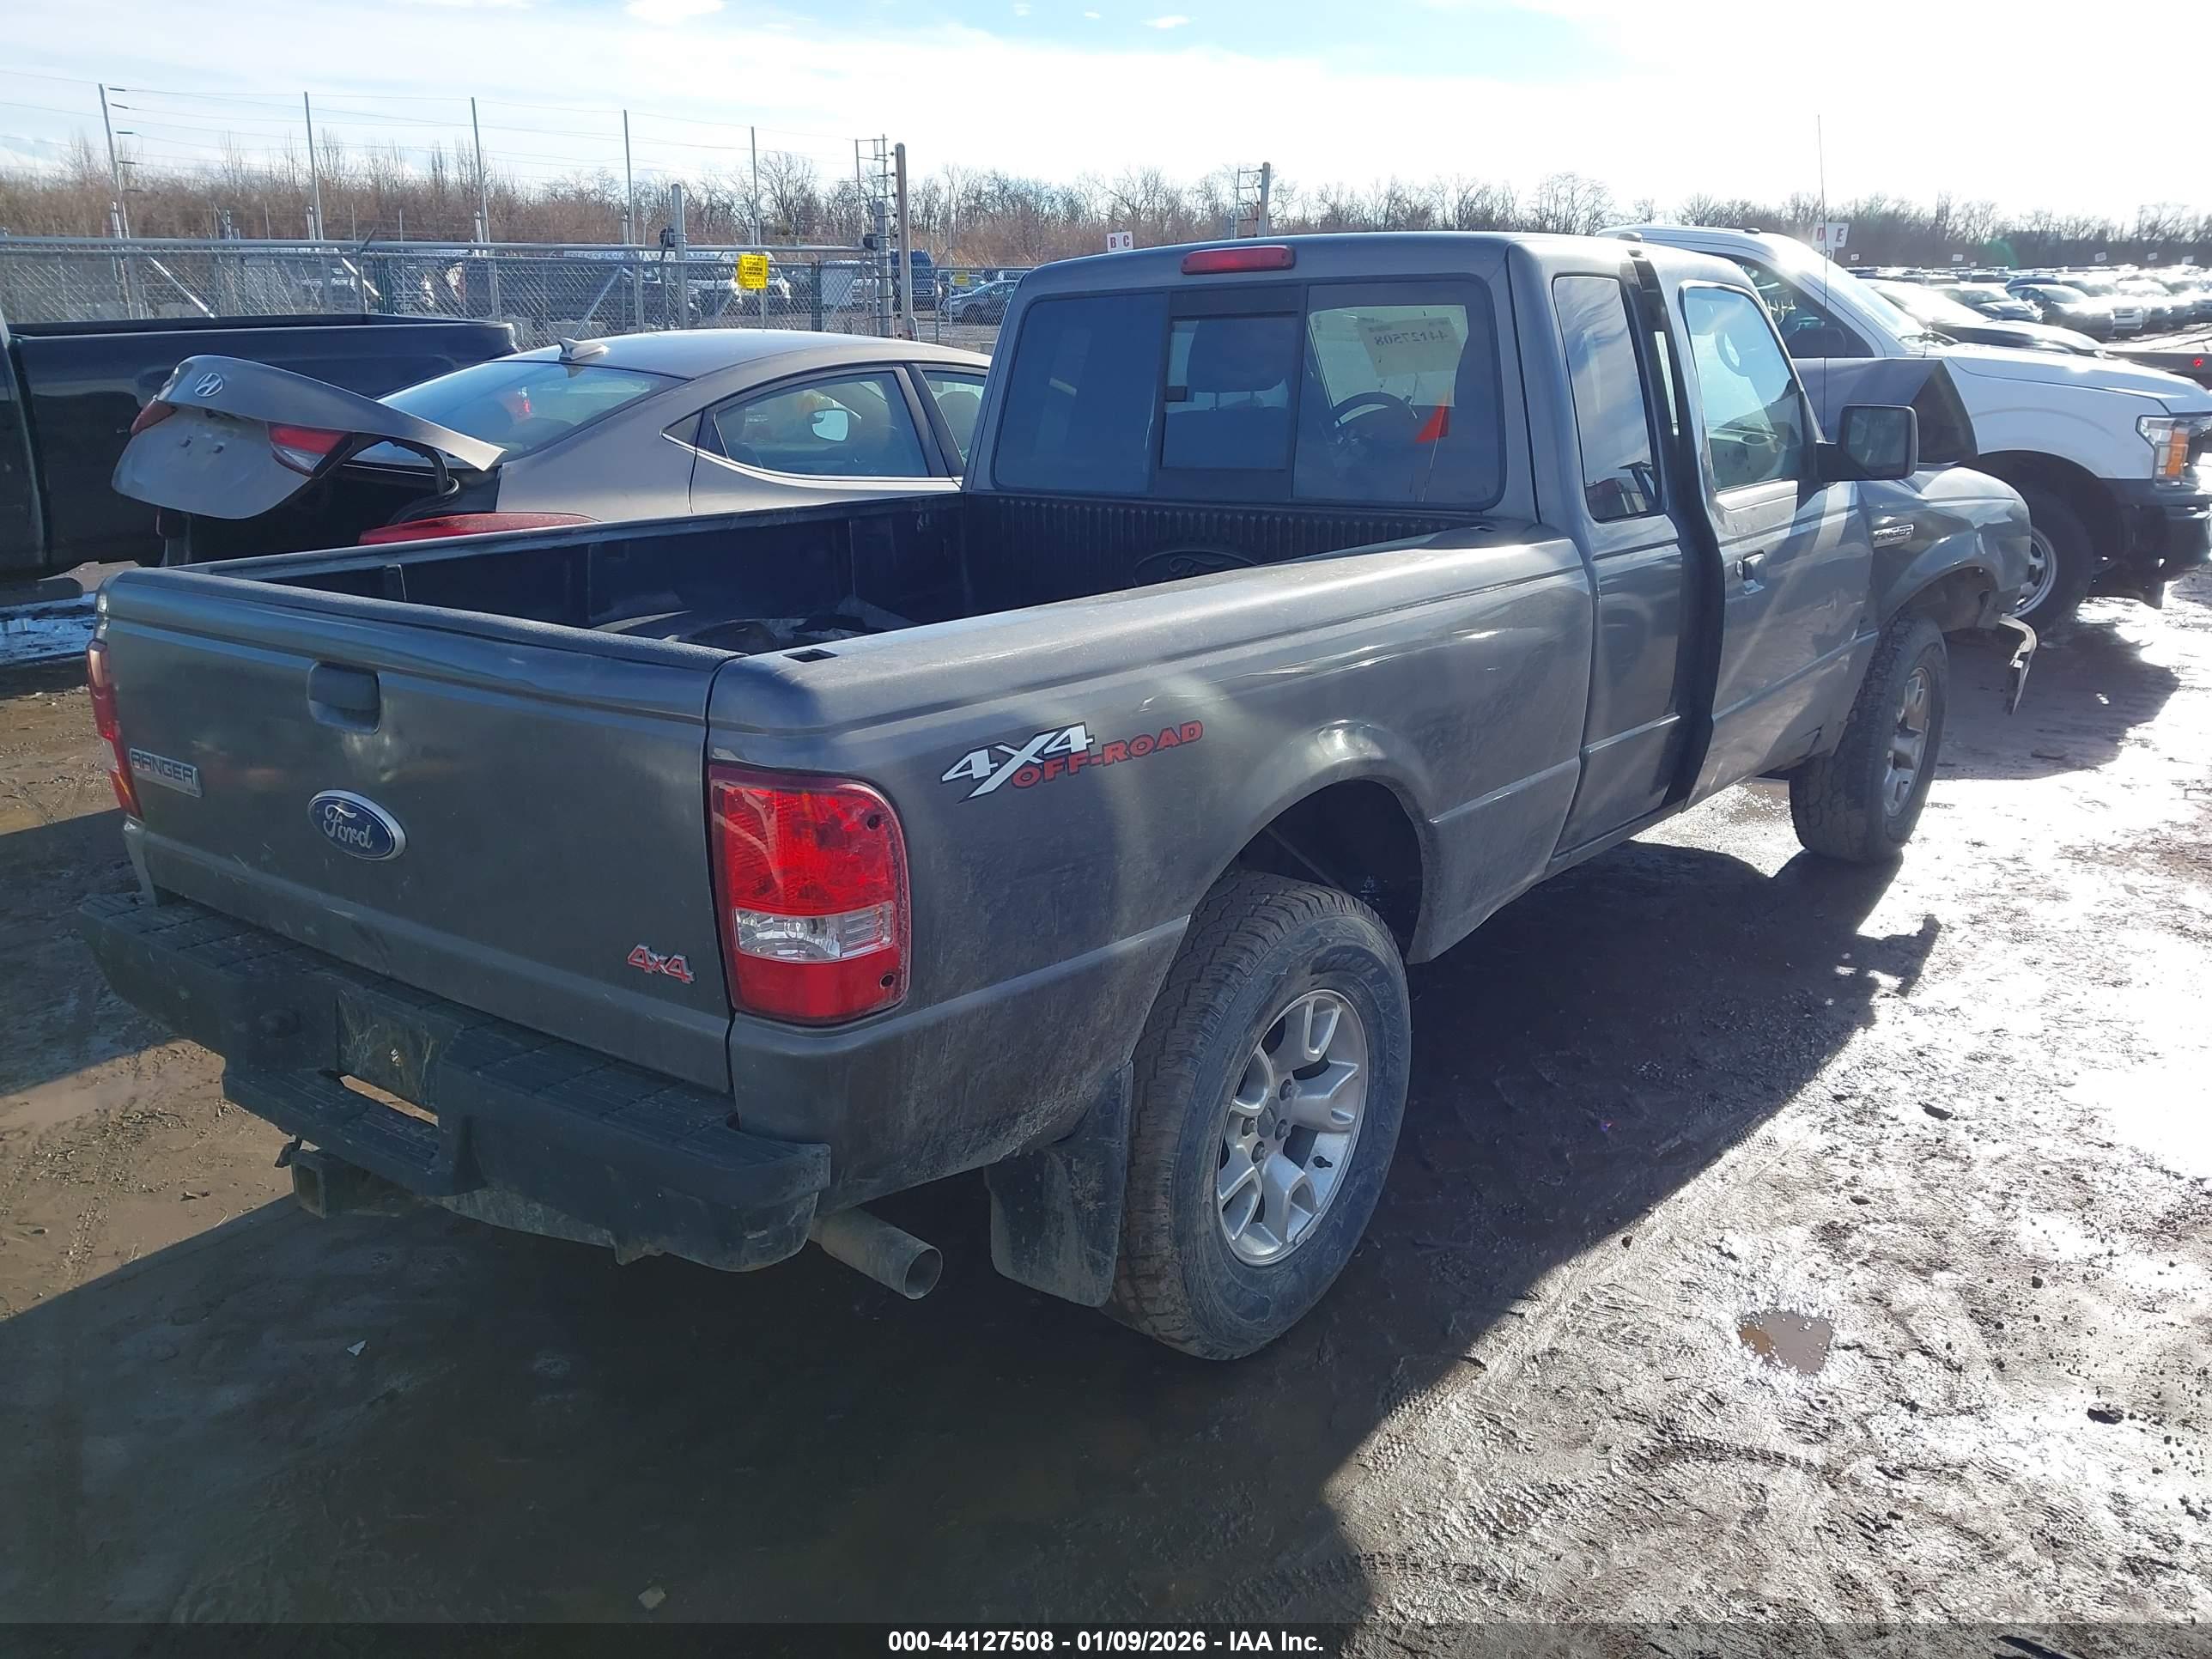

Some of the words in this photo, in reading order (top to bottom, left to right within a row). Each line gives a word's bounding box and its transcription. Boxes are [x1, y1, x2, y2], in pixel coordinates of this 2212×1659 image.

[1109, 236, 1117, 248] B
[1122, 234, 1130, 247] C
[1816, 227, 1826, 241] D
[1835, 227, 1844, 242] E
[131, 750, 195, 785] RANGER
[1011, 720, 1204, 789] OFF-ROAD
[322, 804, 374, 849] Ford
